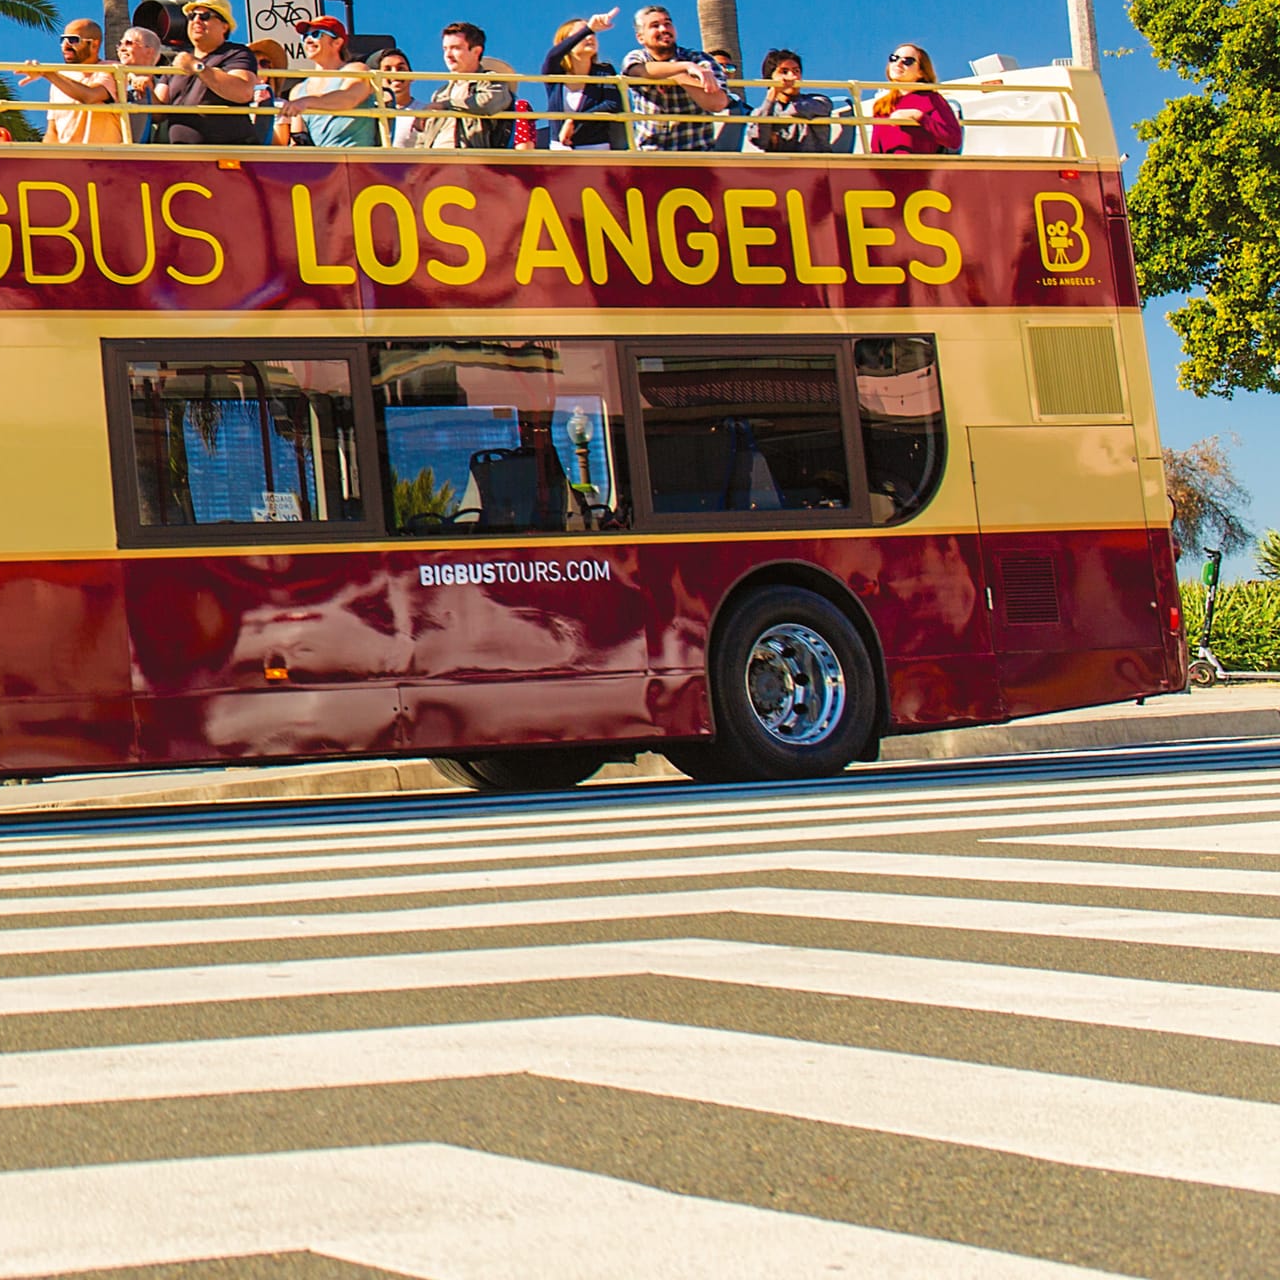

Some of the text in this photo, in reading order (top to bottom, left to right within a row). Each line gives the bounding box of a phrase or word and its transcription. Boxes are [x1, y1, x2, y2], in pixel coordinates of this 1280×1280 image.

[291, 183, 487, 286] LOS
[515, 187, 964, 286] ANGELES
[1042, 277, 1095, 286] LOS ANGELES
[419, 560, 611, 586] BIGBUSTOURS.COM
